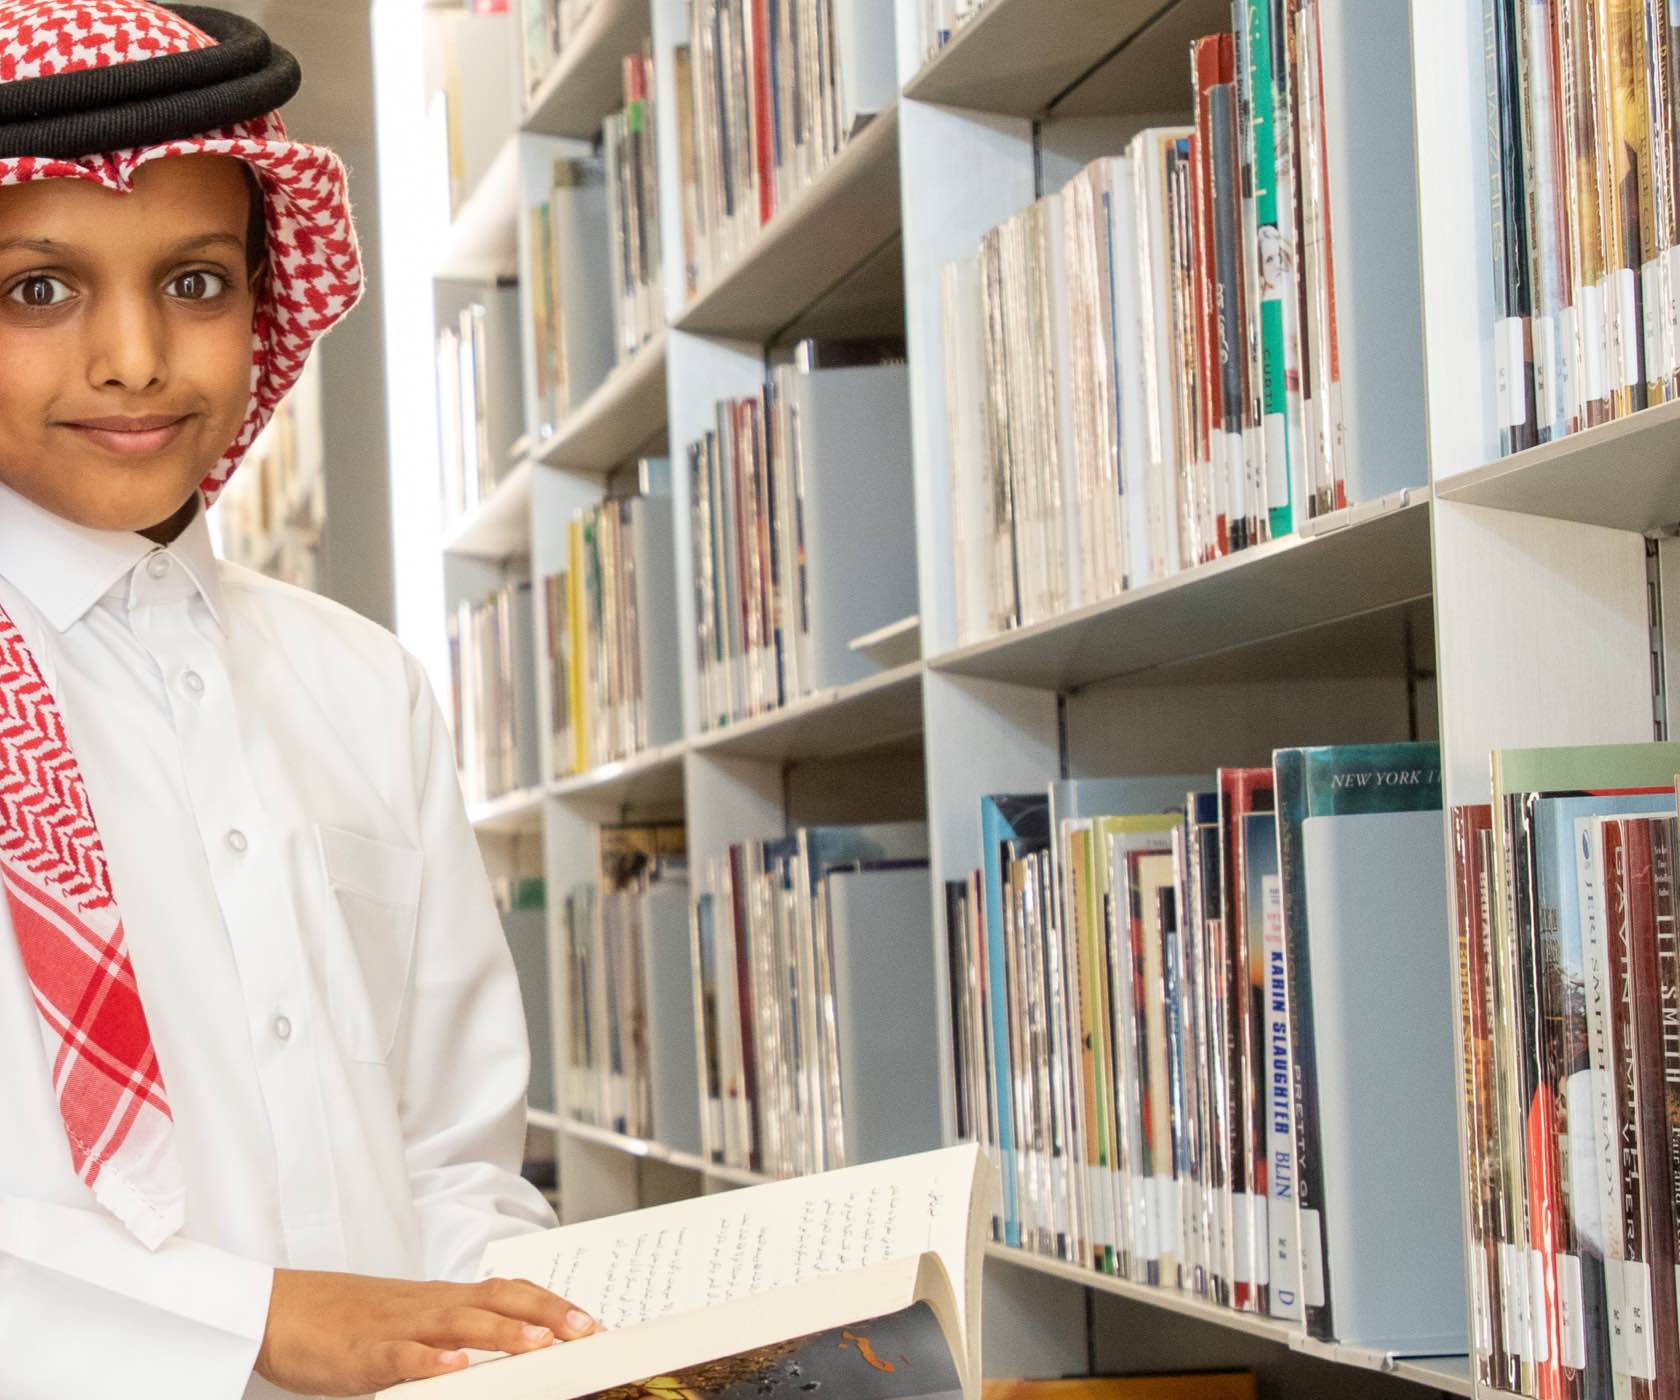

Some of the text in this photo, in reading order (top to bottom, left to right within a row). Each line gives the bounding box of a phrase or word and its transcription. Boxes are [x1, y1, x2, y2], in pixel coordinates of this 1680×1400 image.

[1484, 10, 1495, 62] THE
[1488, 90, 1500, 165] JAZZ
[1330, 773, 1371, 789] NEW
[1375, 770, 1422, 786] YORK
[1271, 950, 1286, 1012] KARIN
[1614, 843, 1639, 1176] GAVIN SMITH
[1272, 1021, 1289, 1134] SLAUGHTER
[1584, 880, 1615, 1200] JERI SMITH READY
[1660, 983, 1680, 1081] SMITH
[1295, 1064, 1308, 1167] PRETTY
